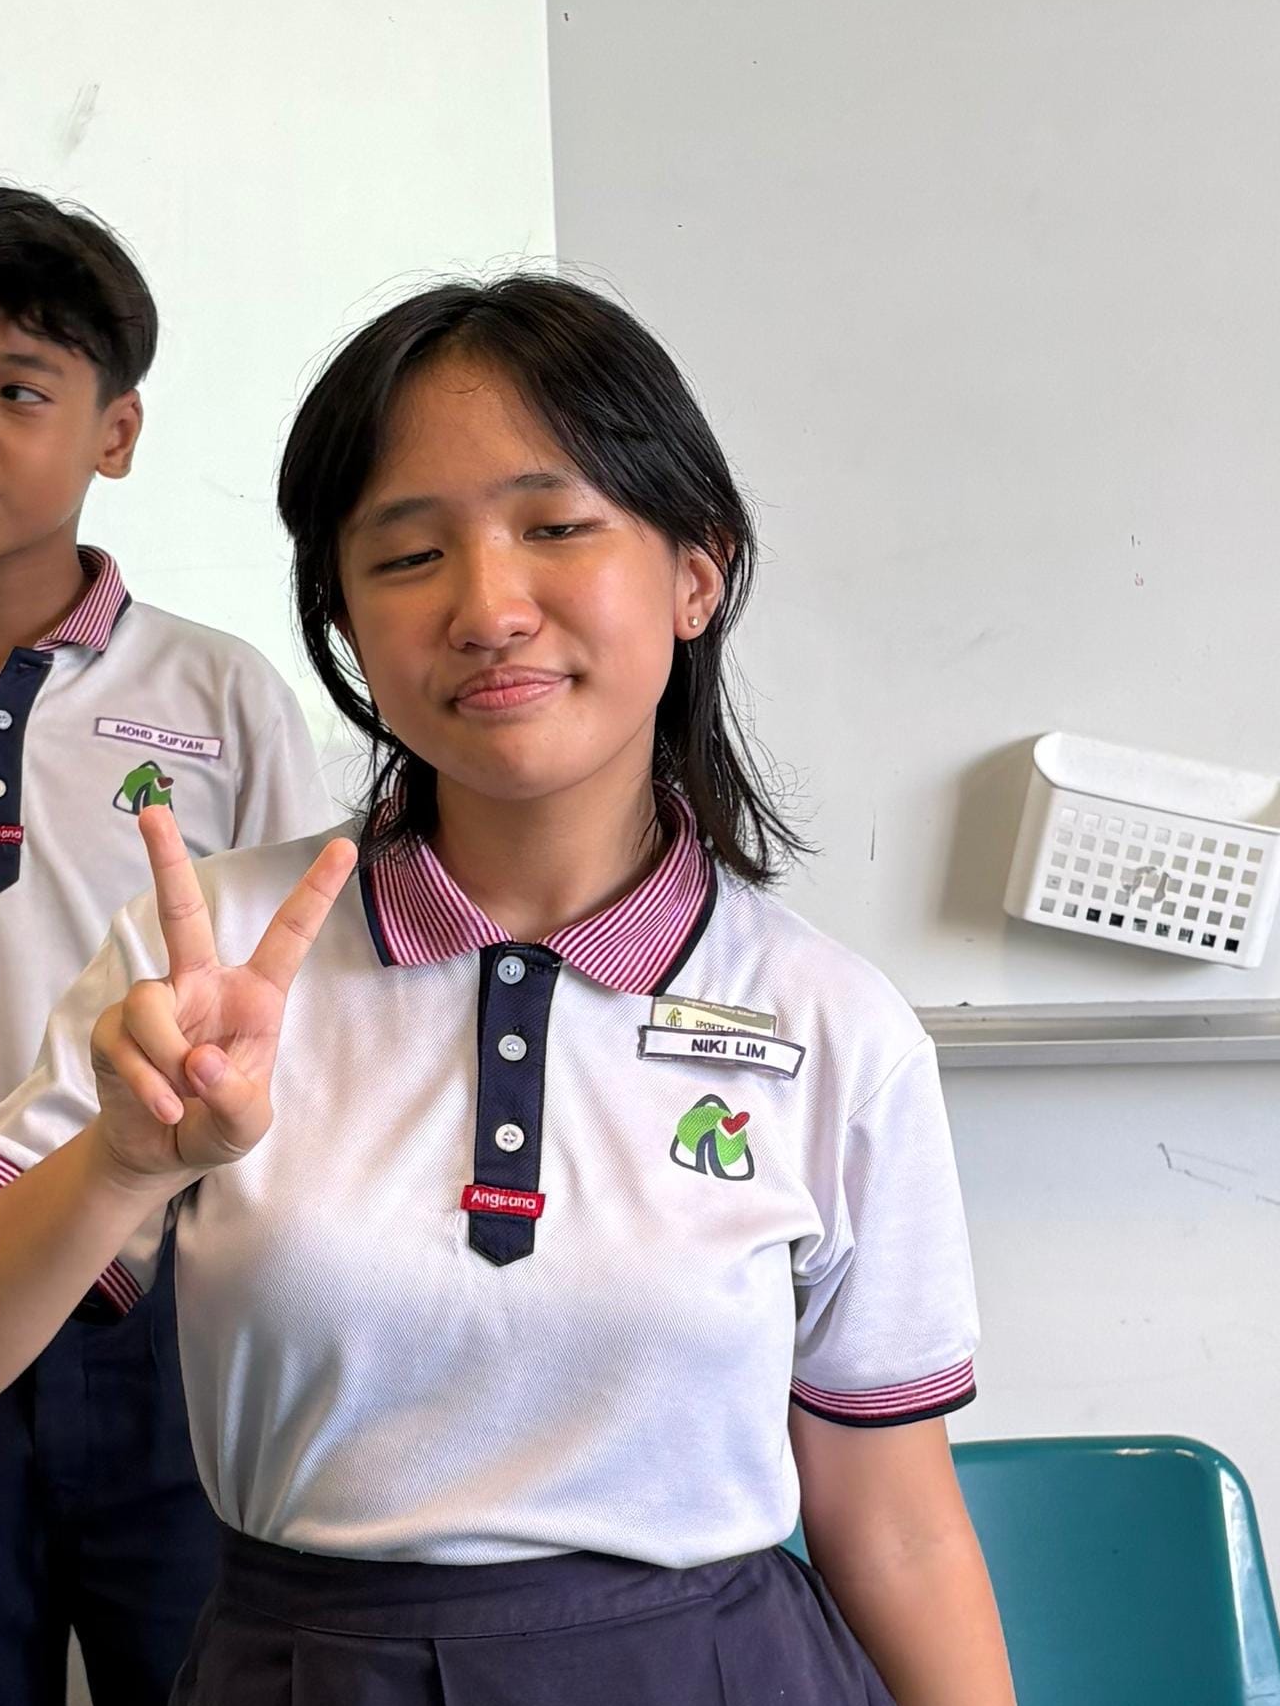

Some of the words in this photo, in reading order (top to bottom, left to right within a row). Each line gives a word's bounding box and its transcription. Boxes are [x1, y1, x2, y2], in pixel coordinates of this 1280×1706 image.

[116, 725, 152, 741] MOHD
[691, 1038, 727, 1054] NIKI
[735, 1041, 766, 1059] LIM
[471, 1190, 536, 1210] Angsana
